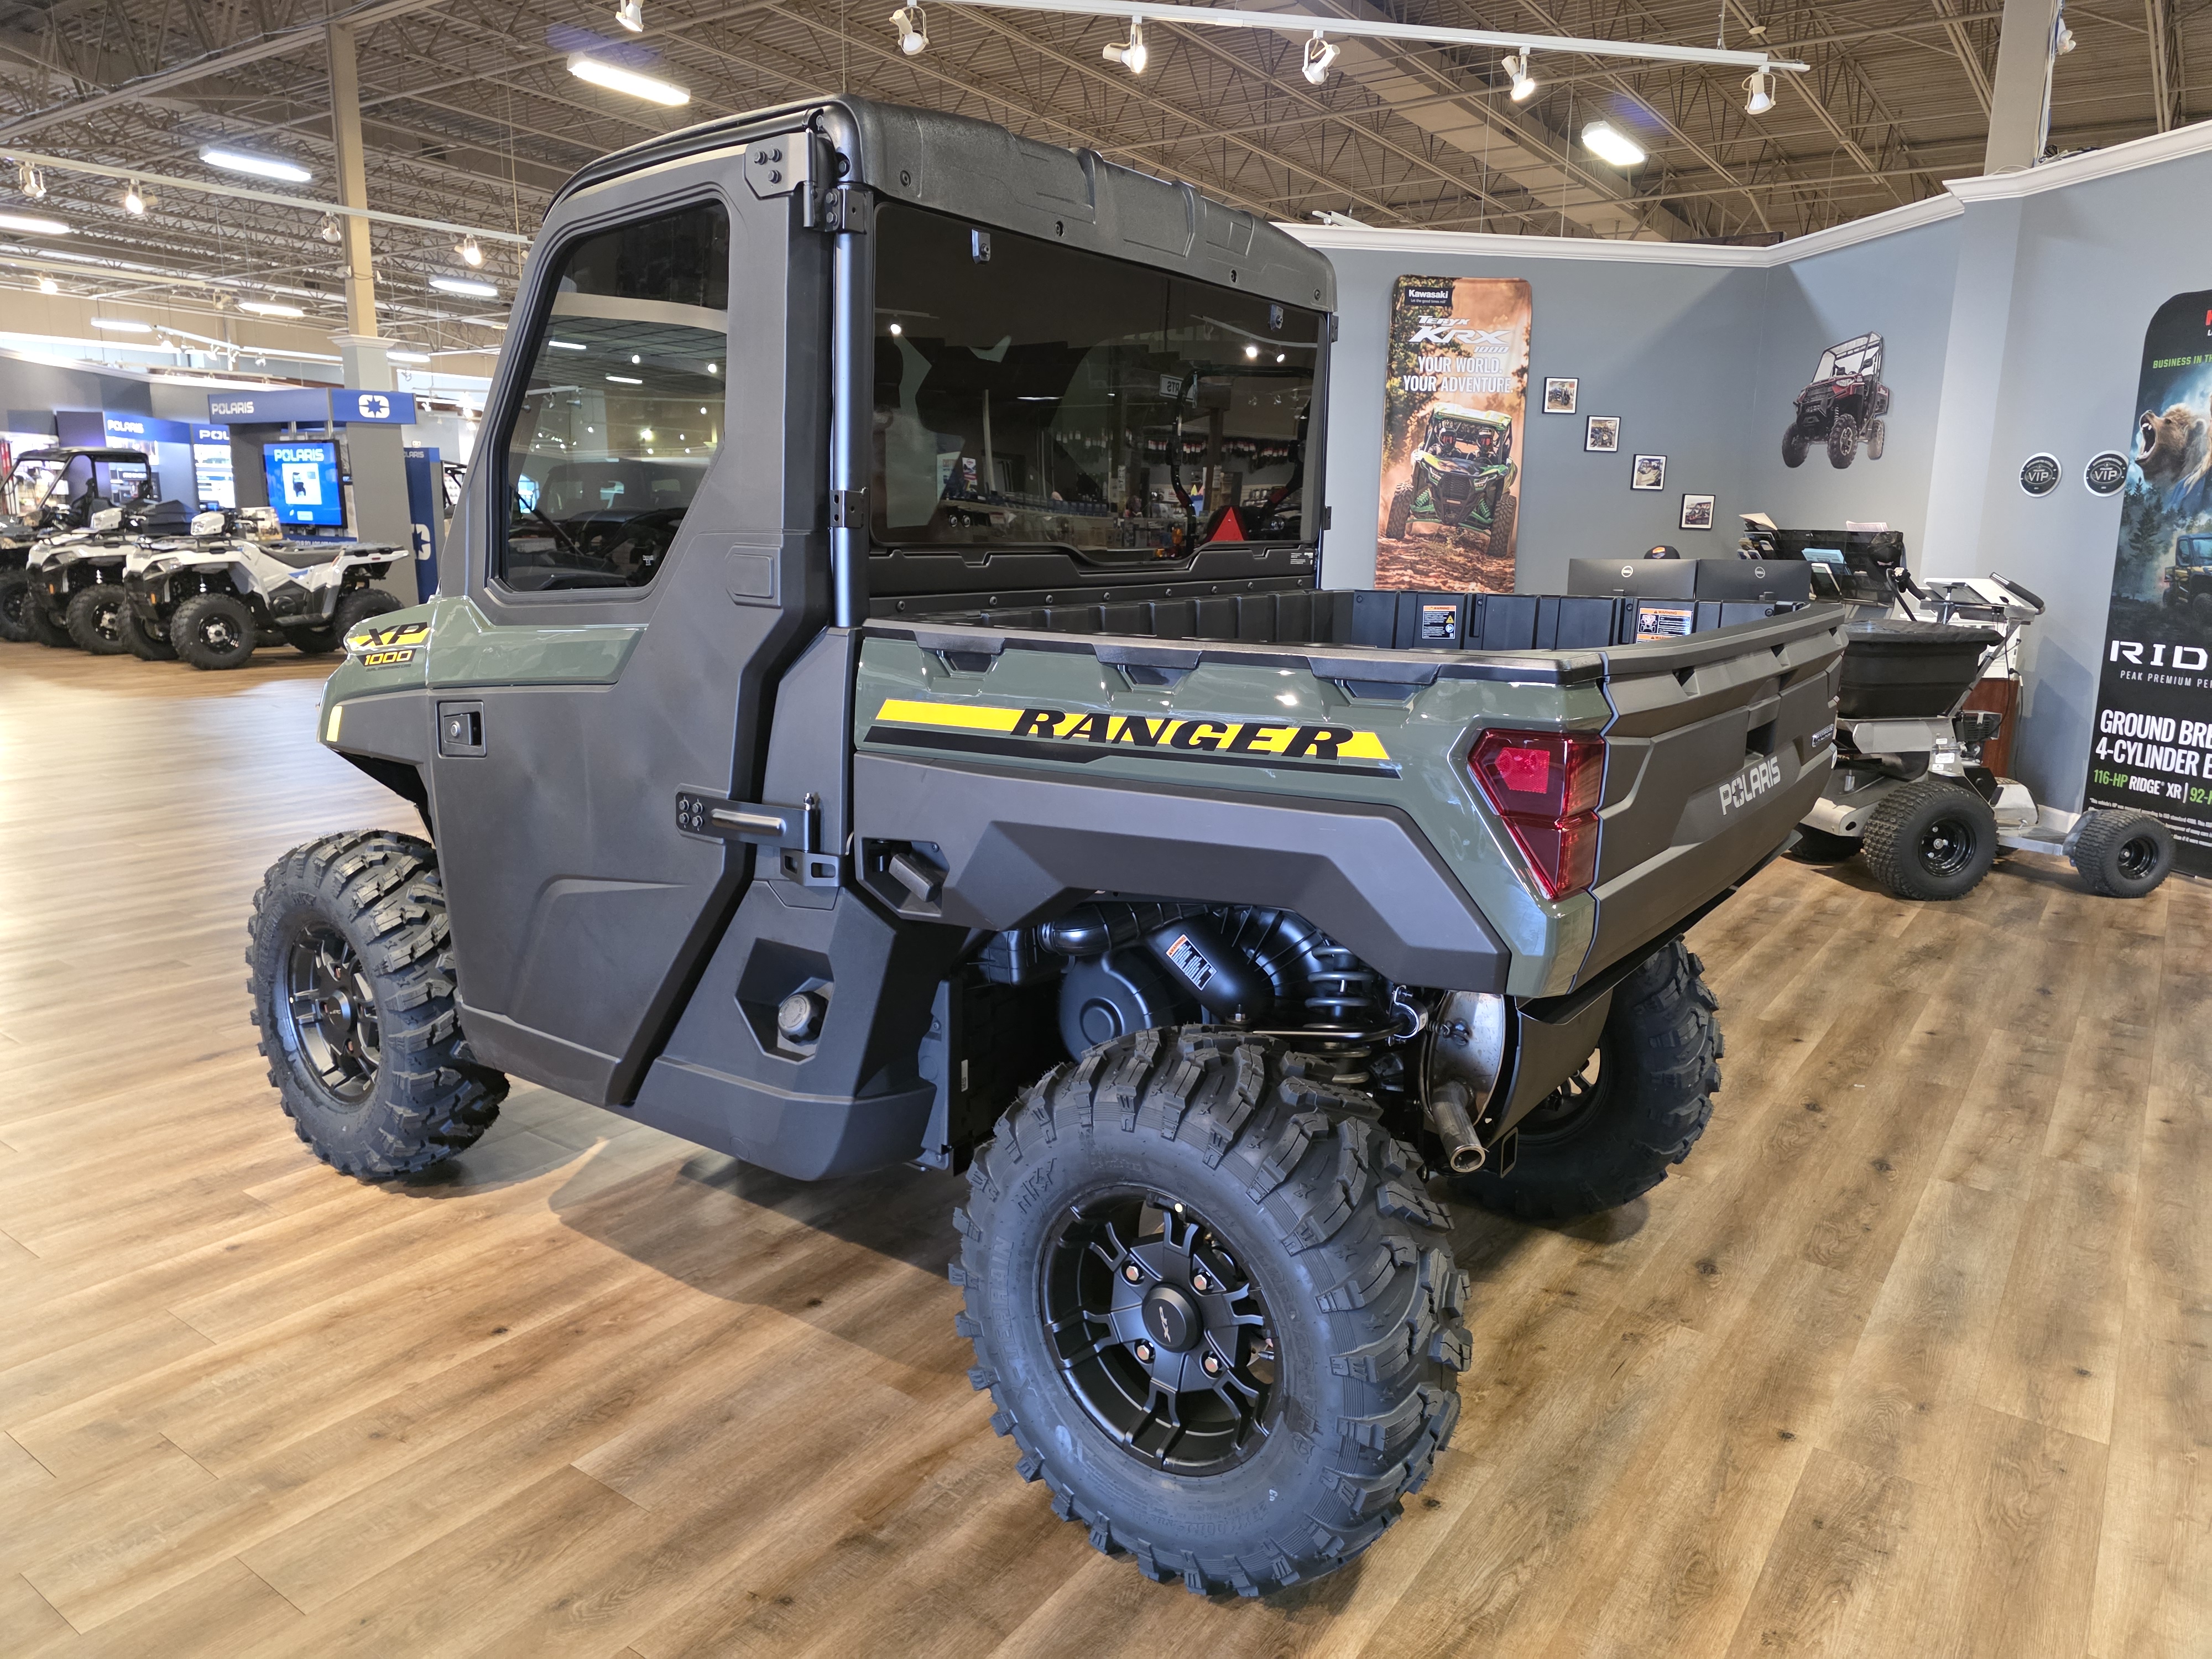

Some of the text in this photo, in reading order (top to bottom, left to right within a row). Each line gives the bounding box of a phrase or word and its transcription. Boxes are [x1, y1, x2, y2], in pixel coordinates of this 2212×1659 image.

[1408, 289, 1448, 299] Kawasaki
[1408, 326, 1513, 345] KRX
[1418, 356, 1503, 373] YOUR WORLD.
[2153, 357, 2192, 369] BUSINESS
[2193, 355, 2202, 364] IN
[1403, 375, 1514, 393] YOUR ADVENTURE.
[212, 401, 254, 415] POLARIS
[107, 419, 144, 434] POLARIS
[199, 430, 229, 440] POL
[274, 448, 324, 462] POLARIS
[2028, 472, 2049, 482] VIP
[2094, 470, 2117, 481] VIP
[360, 622, 427, 646] XP
[364, 650, 413, 666] 1000
[2110, 640, 2208, 671] RID
[2120, 670, 2143, 681] PEAK
[2147, 672, 2192, 686] PREMIUM
[2100, 709, 2176, 743] GROUND
[1010, 708, 1355, 761] RANGER
[2095, 737, 2200, 776] 4-CYLINDER
[1719, 755, 1781, 816] POLARIS
[2094, 769, 2128, 788] 116-HP
[2166, 782, 2182, 799] XR
